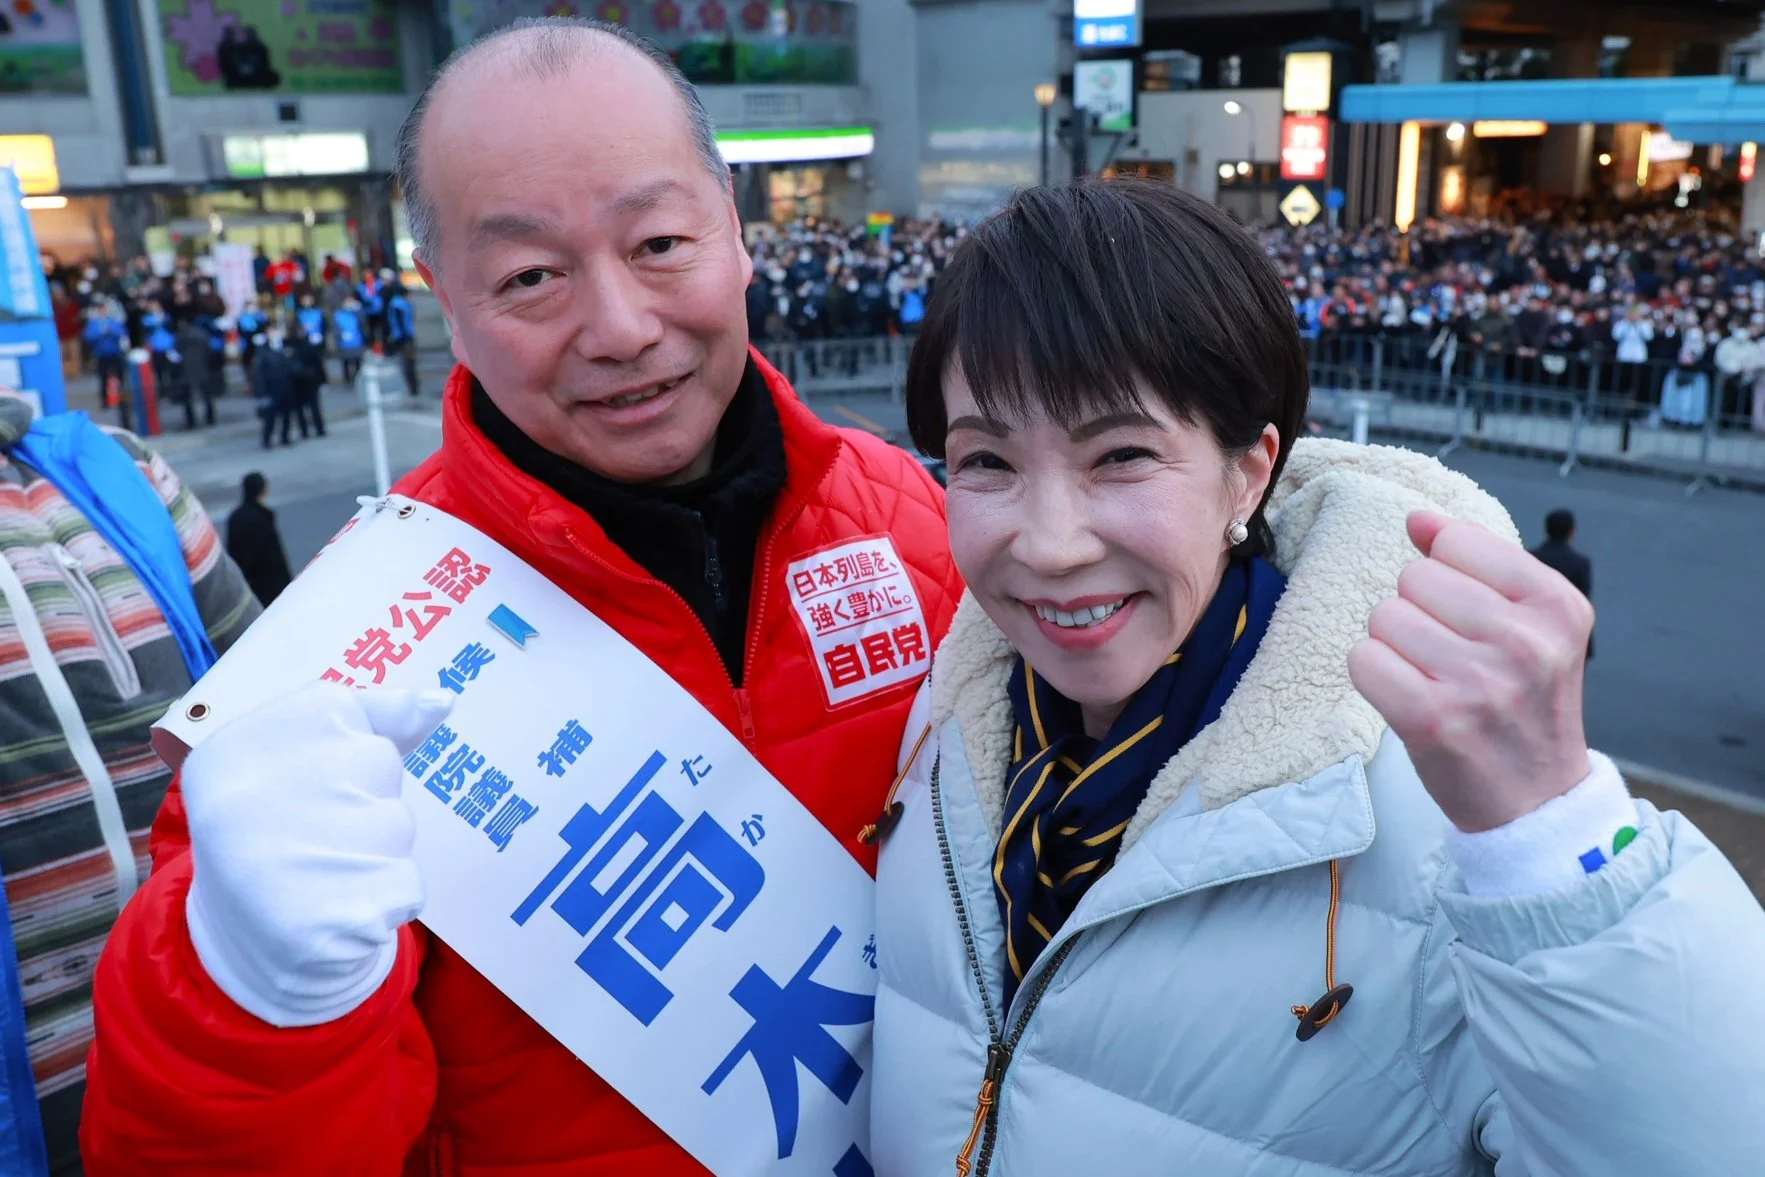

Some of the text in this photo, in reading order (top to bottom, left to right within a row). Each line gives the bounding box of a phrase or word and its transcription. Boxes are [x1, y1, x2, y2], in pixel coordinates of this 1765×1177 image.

[793, 550, 898, 598] 日本列島を、
[320, 546, 491, 689] 党公認
[807, 585, 912, 631] 強く豊かに。
[823, 622, 927, 689] 自民党
[510, 750, 877, 1177] 高木
